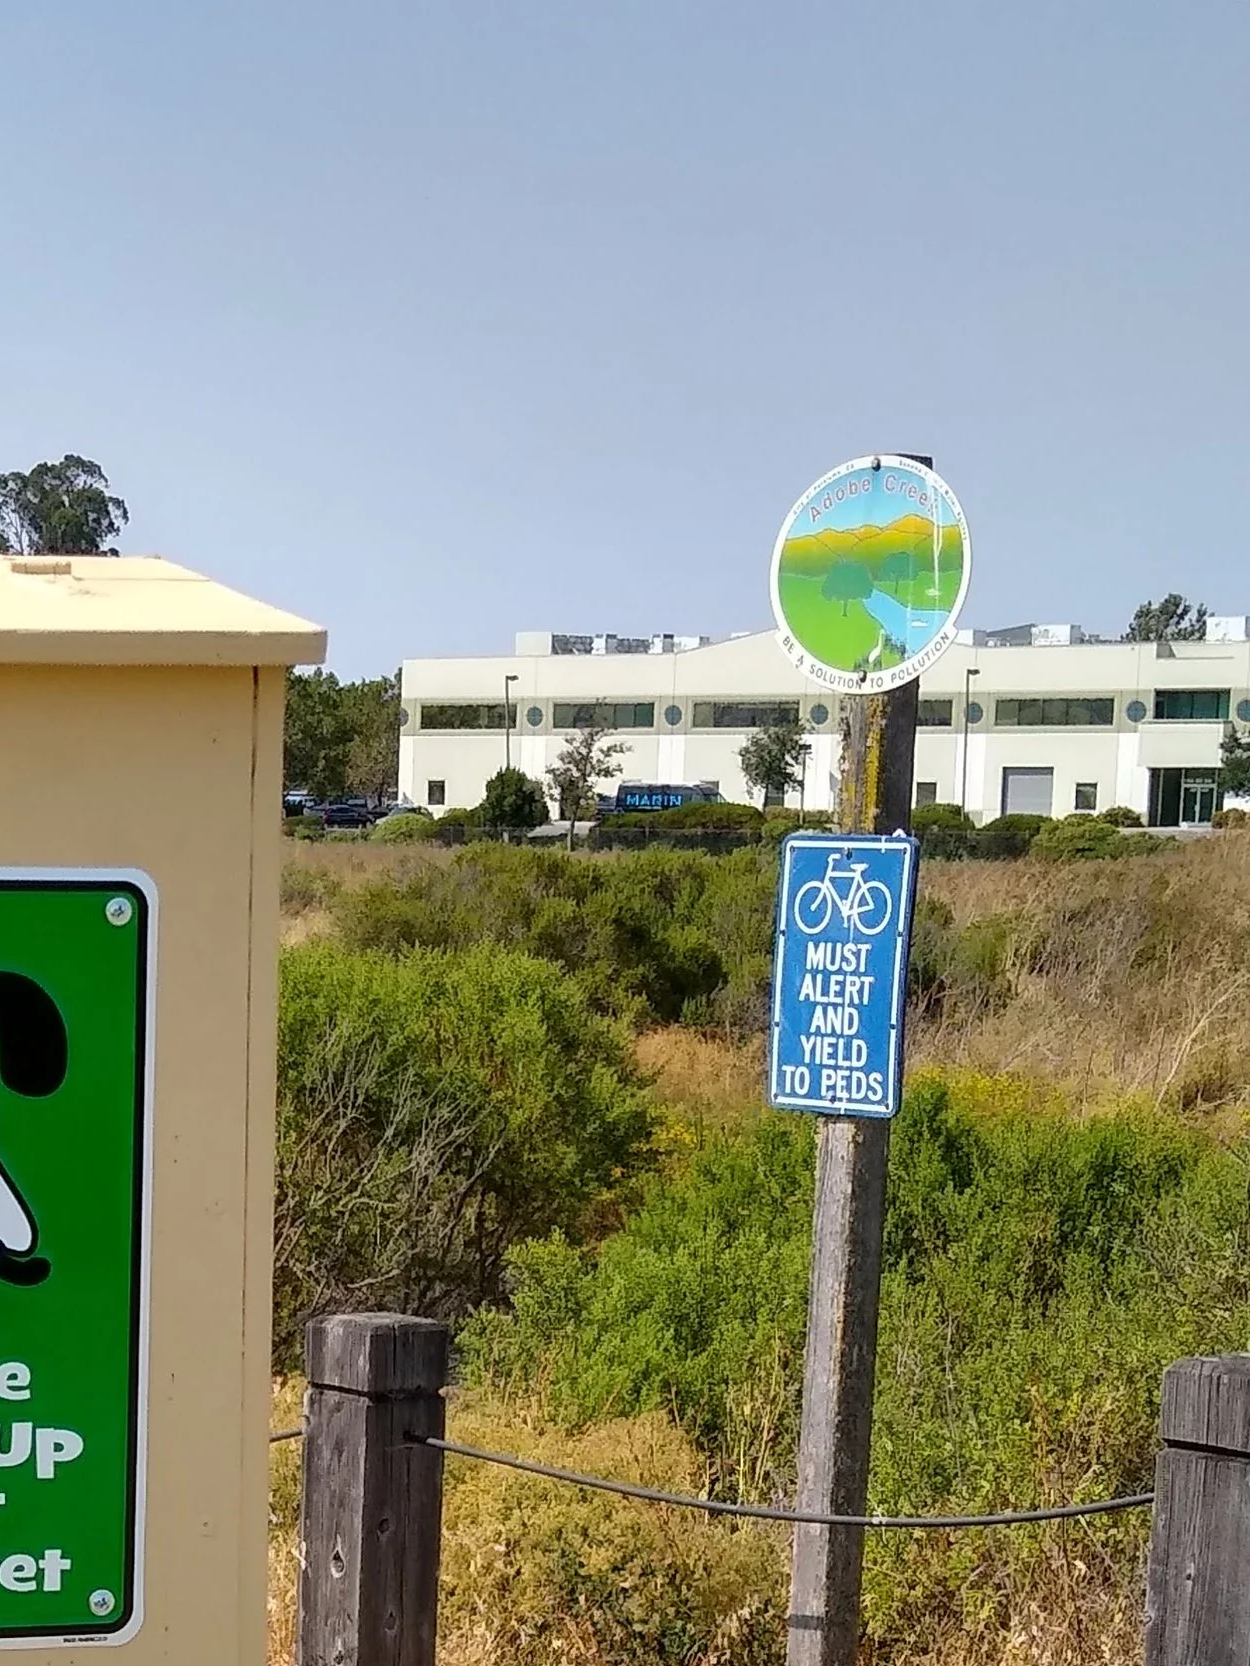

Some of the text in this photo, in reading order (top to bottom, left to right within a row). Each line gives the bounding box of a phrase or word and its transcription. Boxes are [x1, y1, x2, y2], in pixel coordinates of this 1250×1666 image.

[809, 478, 871, 522] Adobe
[782, 632, 950, 690] BE A SOLUTION TO POLLUTION
[805, 941, 872, 973] MUST
[798, 974, 874, 1006] ALERT
[809, 1005, 859, 1036] AND
[800, 1036, 868, 1068] YIELD
[781, 1065, 884, 1102] TO PEDS
